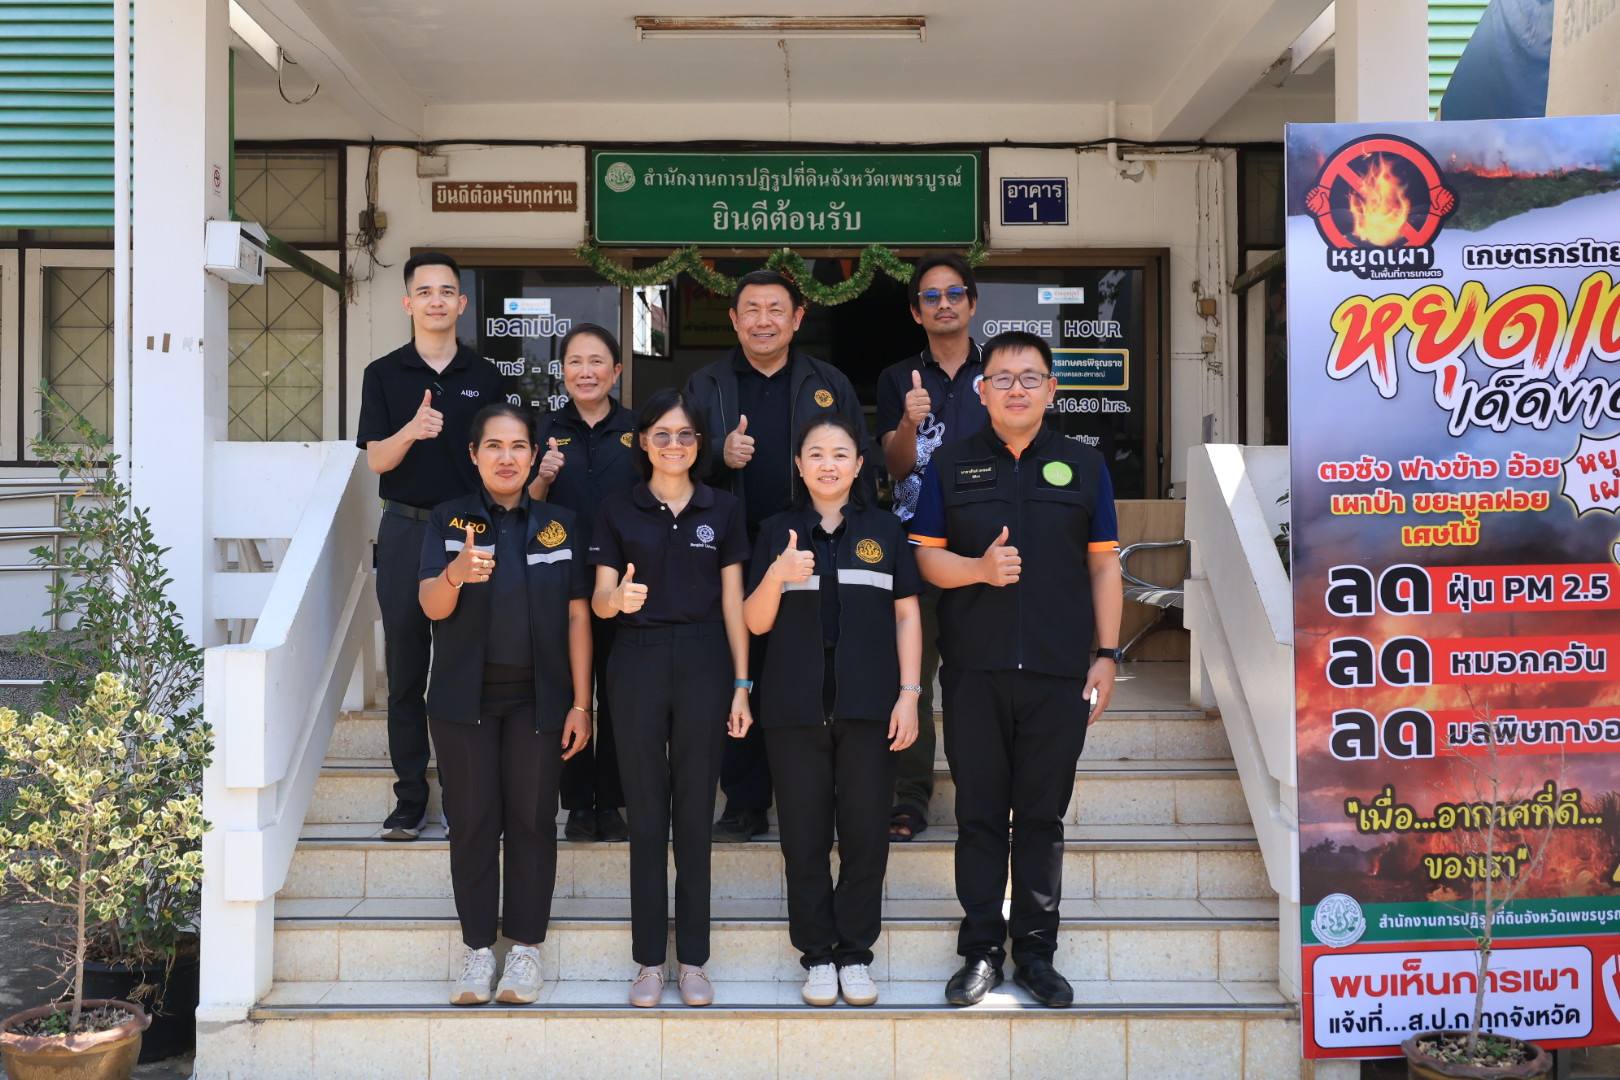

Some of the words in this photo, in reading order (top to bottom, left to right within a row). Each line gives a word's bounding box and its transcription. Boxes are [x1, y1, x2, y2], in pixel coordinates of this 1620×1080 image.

[643, 161, 962, 192] สำนักงานการปฏิรูปที่ดินจังหวัดเพชรบูรณ์
[437, 184, 573, 208] ยินดีต้อนรับทุกท่าน
[1007, 182, 1062, 199] อาคาร
[712, 199, 862, 232] ยินดีต้อนรับ
[1028, 202, 1038, 221] 1
[1331, 247, 1430, 273] หยุดเผา
[1370, 266, 1442, 279] ในพื้นที่การเกษตร
[1064, 320, 1123, 338] HOUR
[1057, 397, 1099, 413] 16.30
[1101, 397, 1131, 413] hrs.
[1319, 456, 1391, 481] ตอซัง
[1400, 454, 1498, 479] ฟางข้าว
[1507, 453, 1560, 477] อ้อย
[1332, 490, 1404, 513] เผาป่า
[1414, 489, 1549, 516] ขยะมูลฝอย
[1402, 519, 1480, 546] เศษไม้
[1326, 564, 1430, 616] ลด
[1448, 573, 1494, 612] ฝุ่น
[1504, 575, 1553, 603] PM
[1561, 574, 1610, 602] 2.5
[1327, 636, 1432, 688] ลด
[1451, 642, 1606, 674] หมอกควัน
[1330, 708, 1435, 761] ลด
